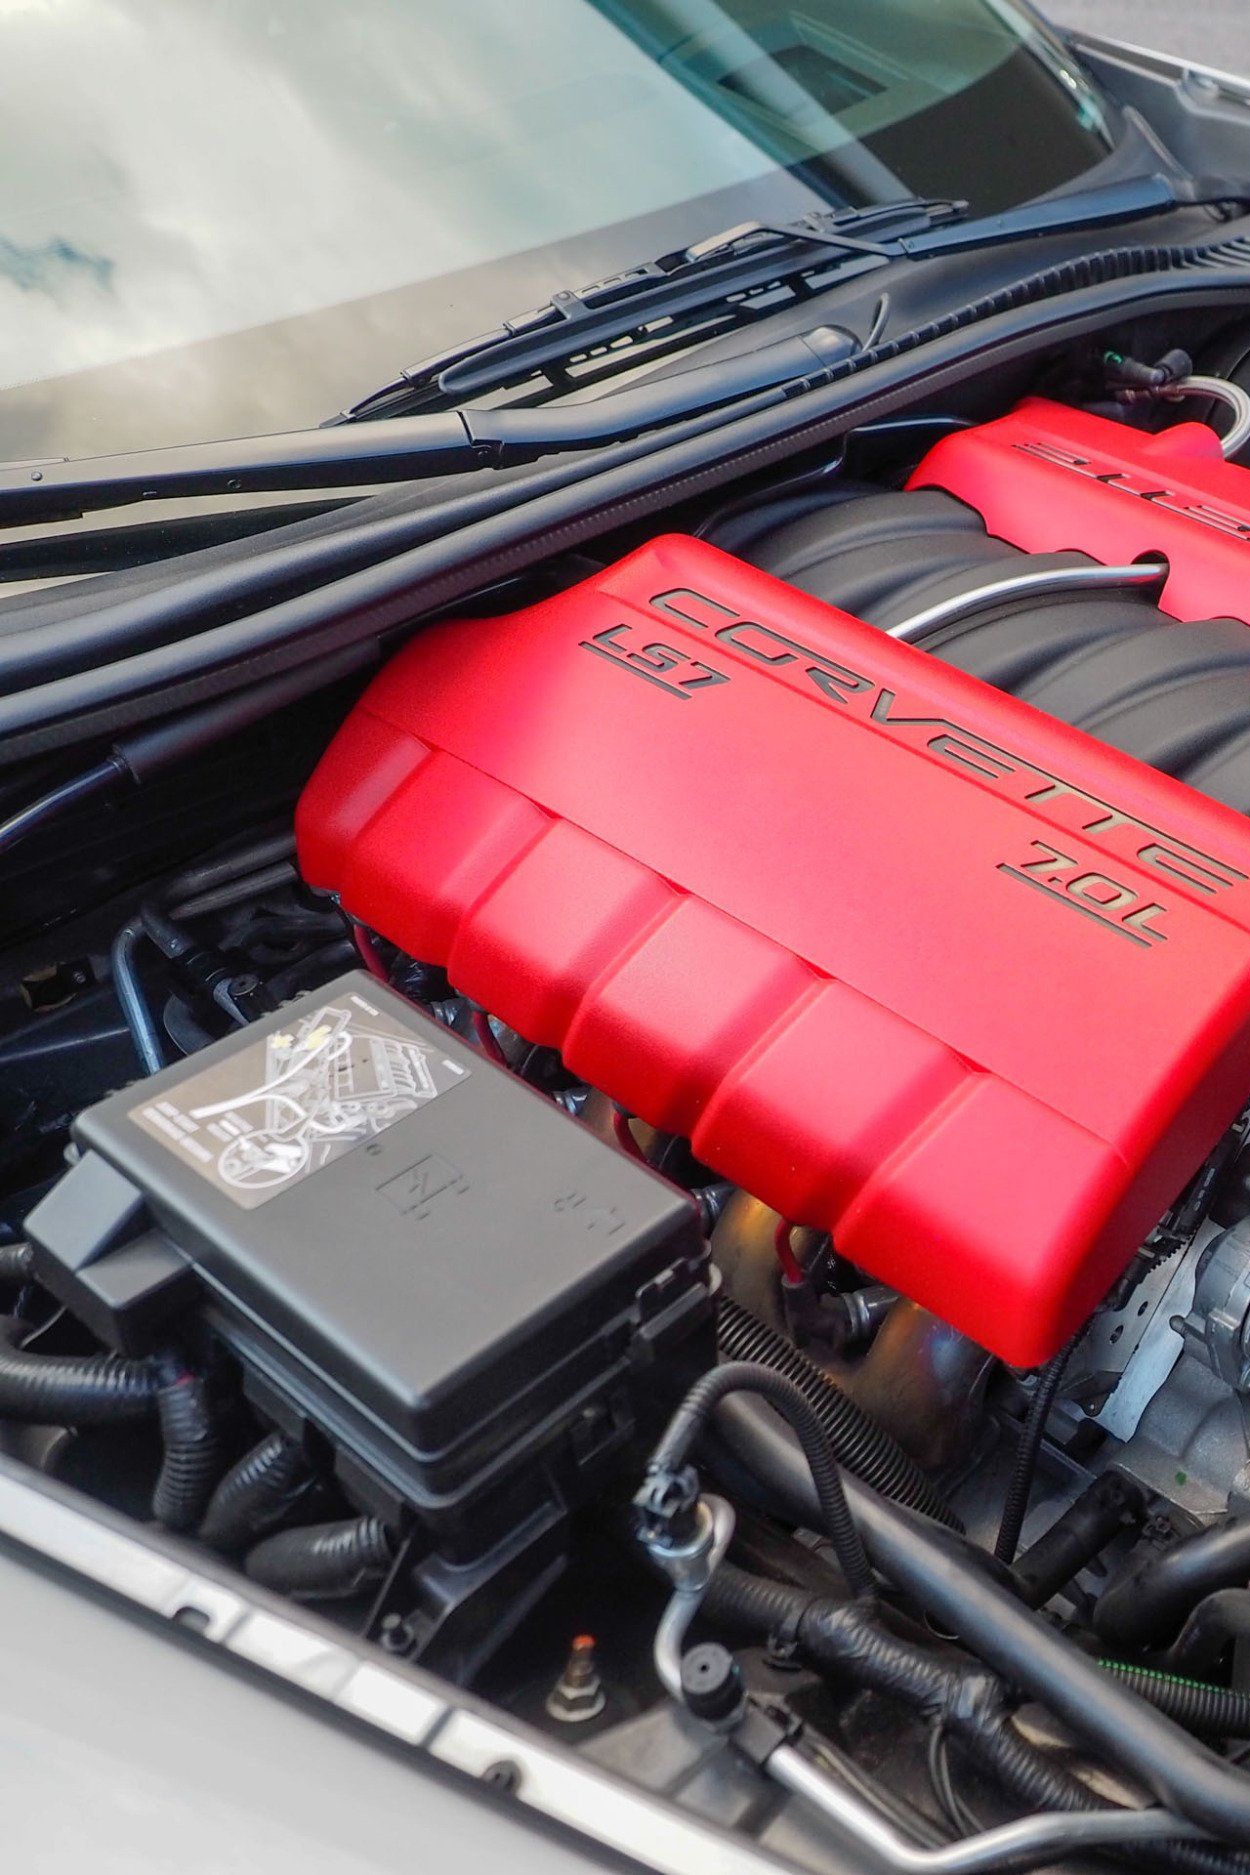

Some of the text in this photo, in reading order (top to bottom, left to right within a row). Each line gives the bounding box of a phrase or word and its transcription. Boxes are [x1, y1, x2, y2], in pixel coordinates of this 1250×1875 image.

[592, 624, 731, 691] LS7
[648, 587, 1249, 894] CORVETTE
[1019, 840, 1170, 942] 7.0L
